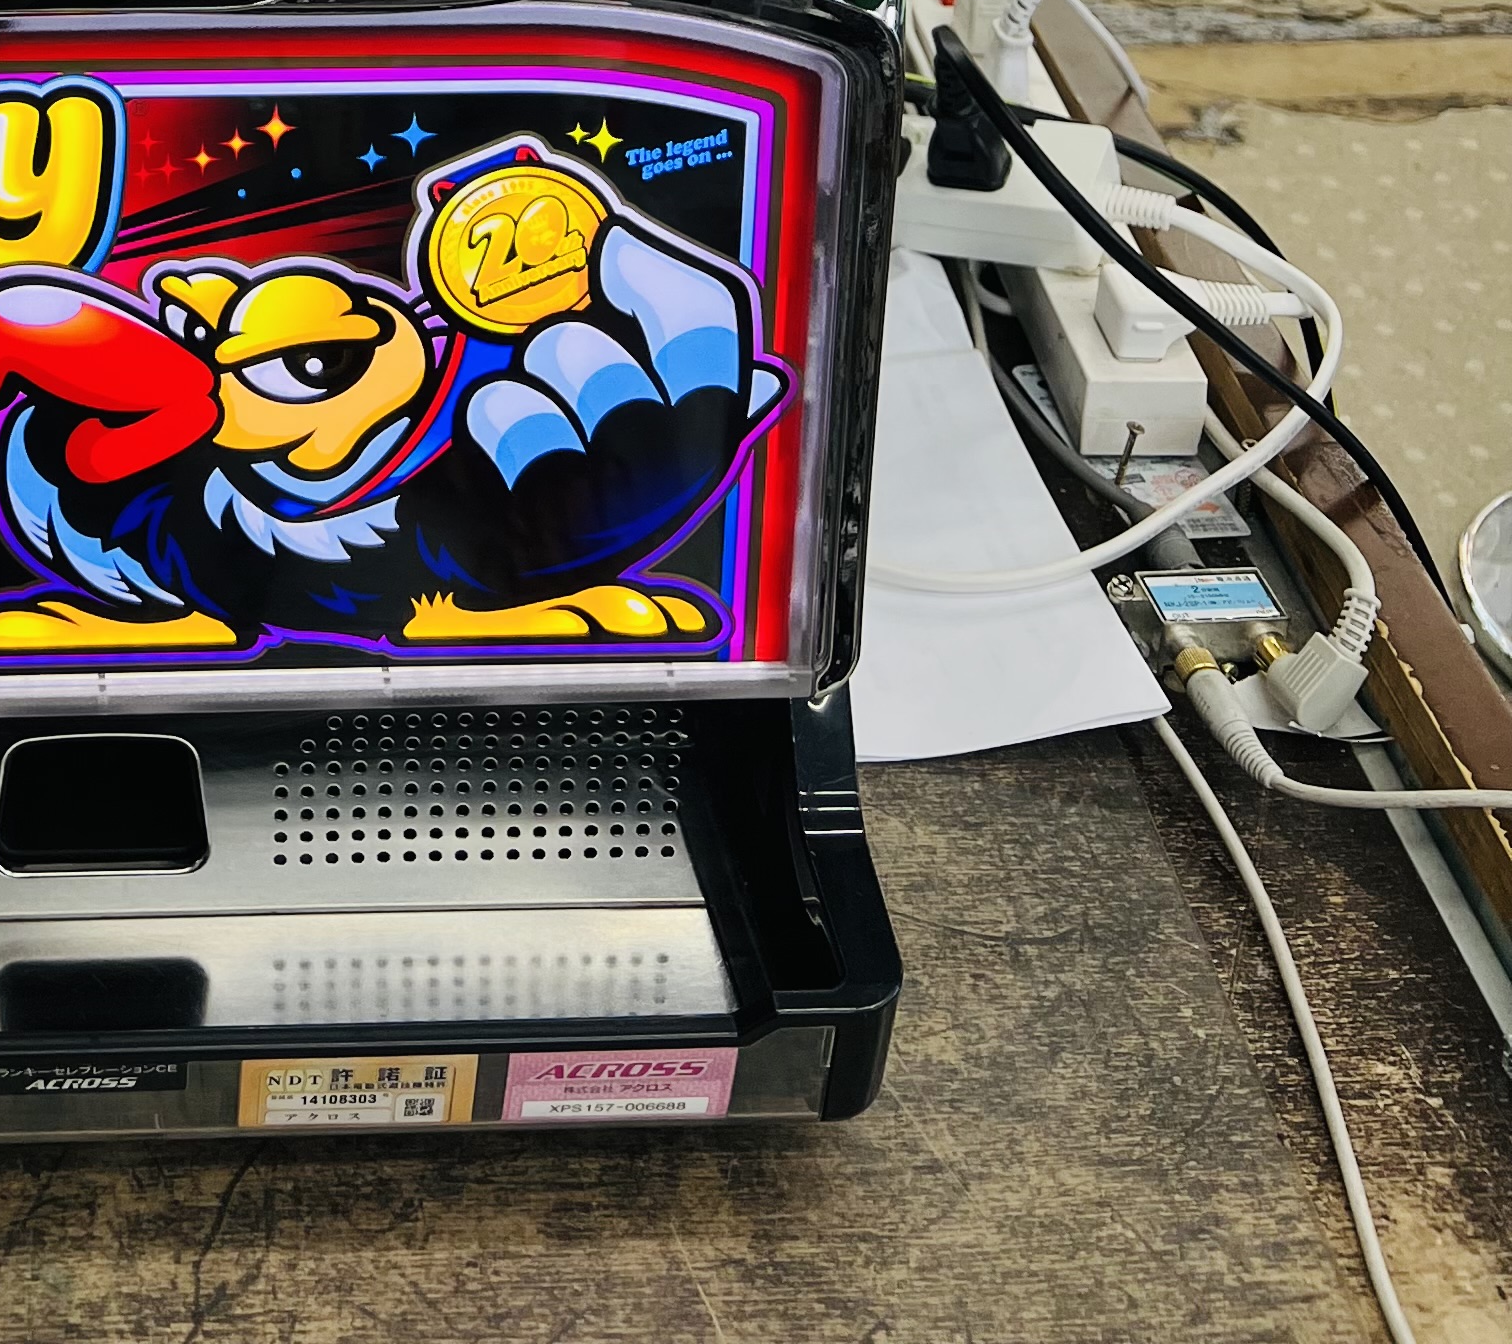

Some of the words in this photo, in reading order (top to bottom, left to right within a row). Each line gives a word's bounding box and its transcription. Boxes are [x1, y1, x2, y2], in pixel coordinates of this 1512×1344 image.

[624, 146, 663, 166] The
[666, 128, 728, 157] legend
[641, 157, 683, 181] goes
[688, 151, 712, 167] on
[534, 1060, 710, 1081] ACROSS
[24, 1076, 139, 1091] ACROSS
[563, 1084, 614, 1094] 株式会社
[619, 1083, 673, 1093] アクロス
[301, 1094, 378, 1106] 14108303
[284, 1112, 362, 1121] アクロス
